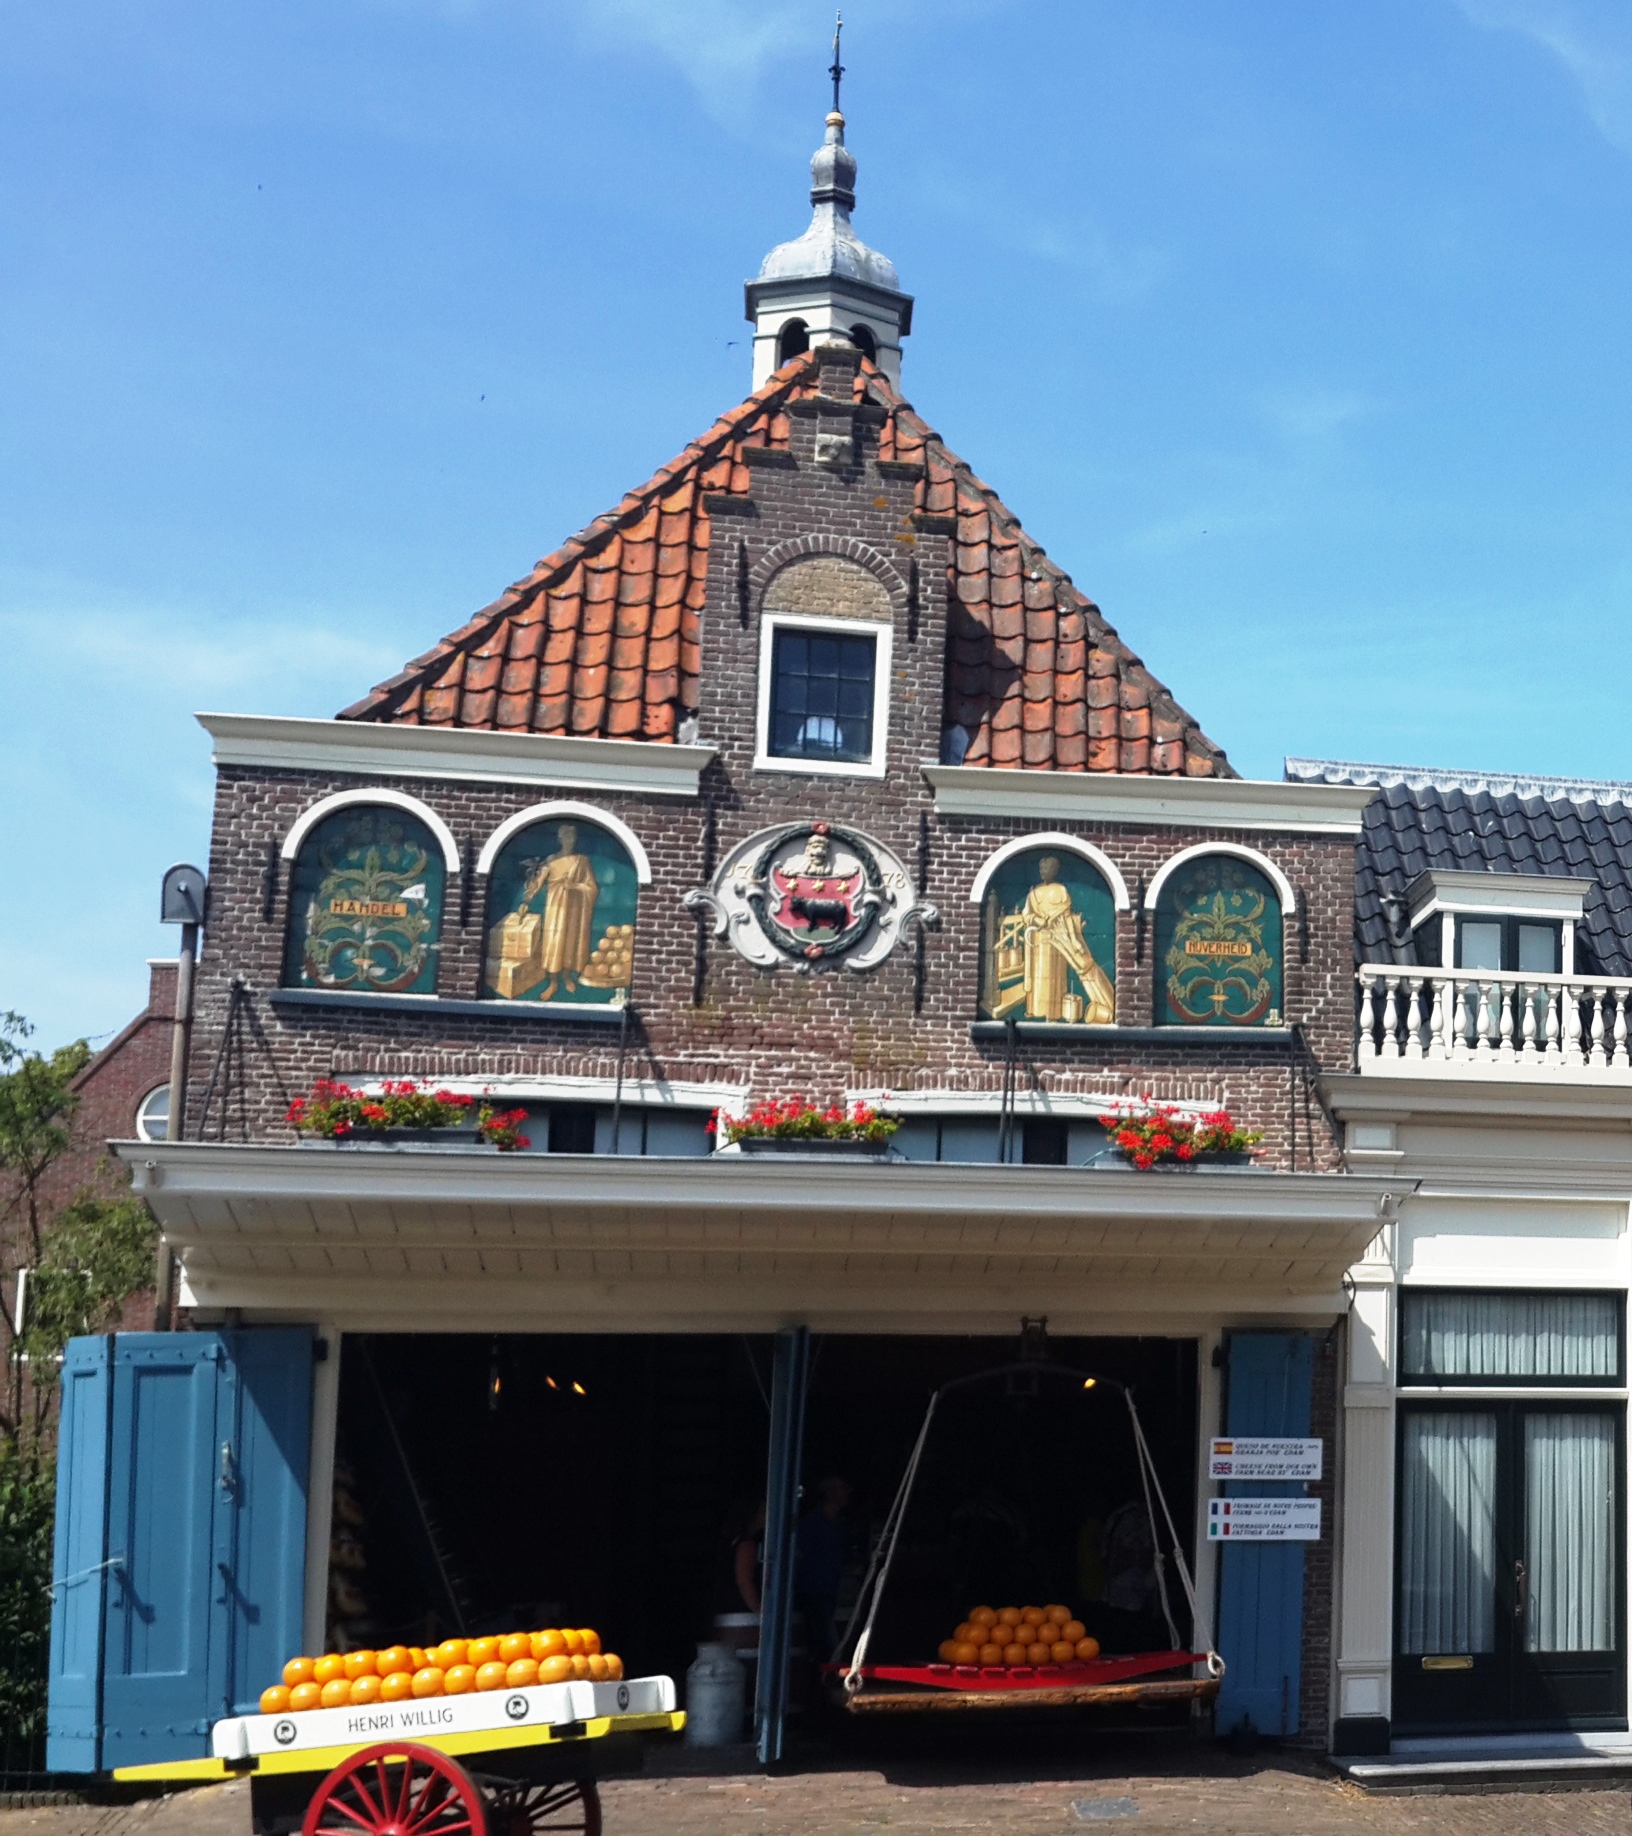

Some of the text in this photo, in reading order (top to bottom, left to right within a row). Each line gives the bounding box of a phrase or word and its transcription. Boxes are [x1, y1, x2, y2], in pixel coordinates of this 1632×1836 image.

[881, 872, 906, 890] 78
[333, 899, 401, 916] HANDEL
[348, 1705, 454, 1732] HENRI WILLIG
